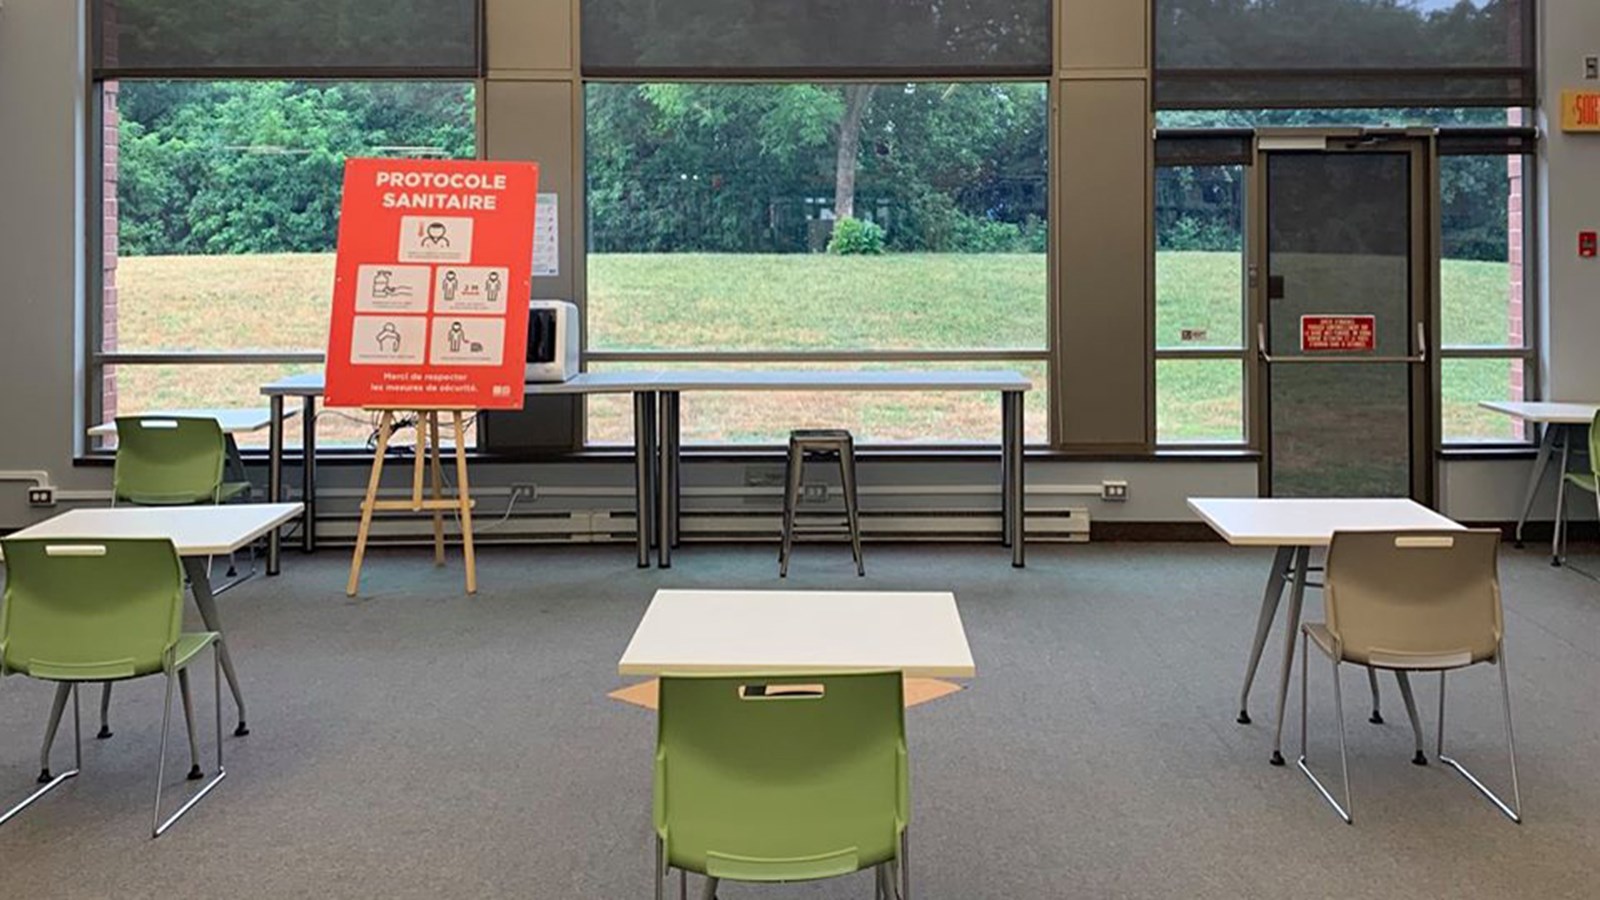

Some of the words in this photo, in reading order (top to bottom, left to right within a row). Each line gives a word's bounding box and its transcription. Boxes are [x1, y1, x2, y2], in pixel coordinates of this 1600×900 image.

[1576, 94, 1600, 125] SOR
[376, 171, 507, 190] PROTOCOLE
[382, 192, 497, 210] SANITAIRE
[383, 372, 408, 381] Merci
[410, 372, 422, 381] de
[424, 373, 468, 383] respecter
[370, 383, 383, 392] les
[385, 384, 424, 393] mesures
[425, 383, 438, 393] de
[439, 383, 479, 394] sécurité.
